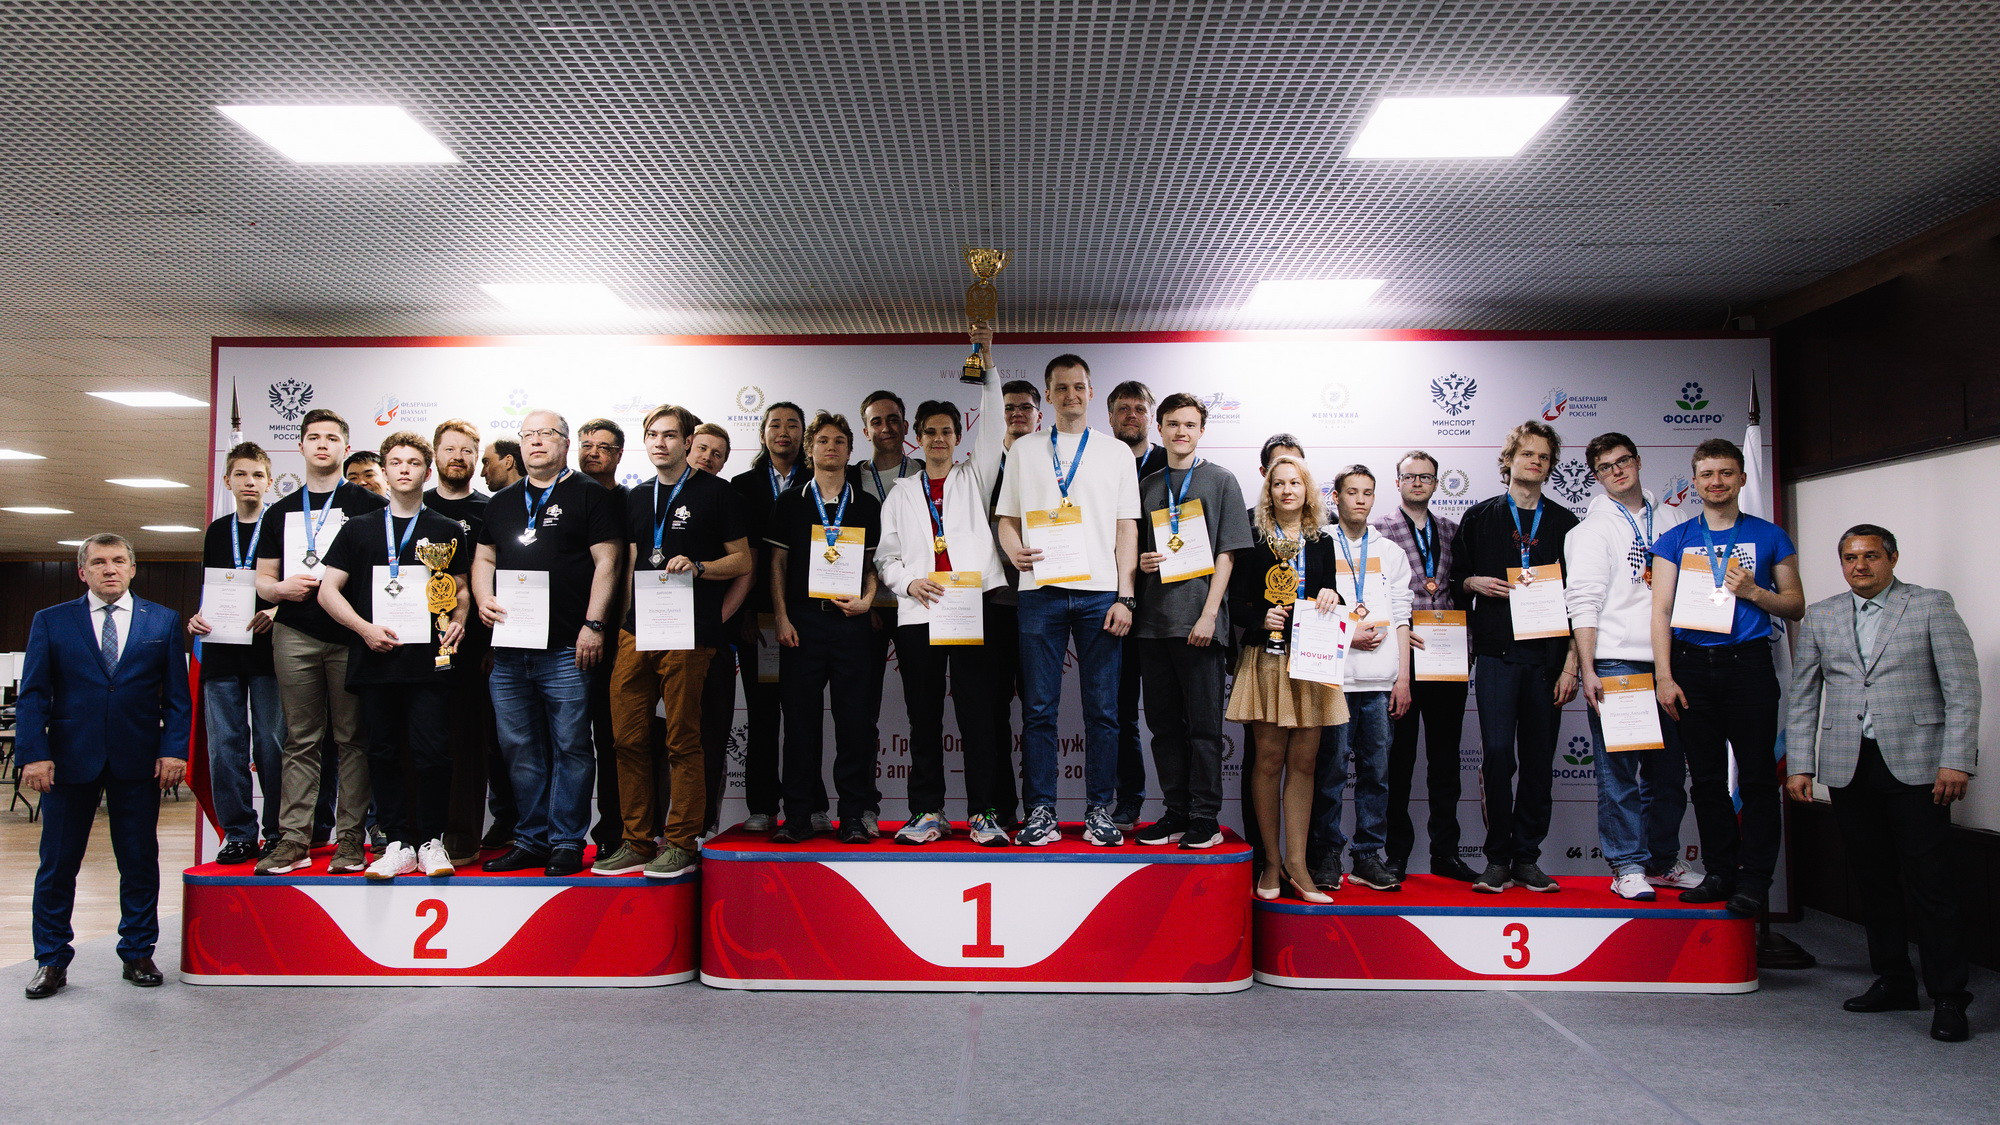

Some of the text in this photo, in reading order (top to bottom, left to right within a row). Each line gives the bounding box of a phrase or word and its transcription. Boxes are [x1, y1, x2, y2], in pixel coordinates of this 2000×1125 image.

[940, 368, 1026, 379] wwwss.ru
[1432, 419, 1476, 427] МИНСПОРТ
[1663, 414, 1722, 424] ФОСАГРО
[268, 424, 302, 432] МИНСПО
[490, 420, 523, 429] ФОСА
[962, 883, 1005, 958] 1
[413, 899, 448, 959] 2
[1503, 923, 1530, 969] 3
